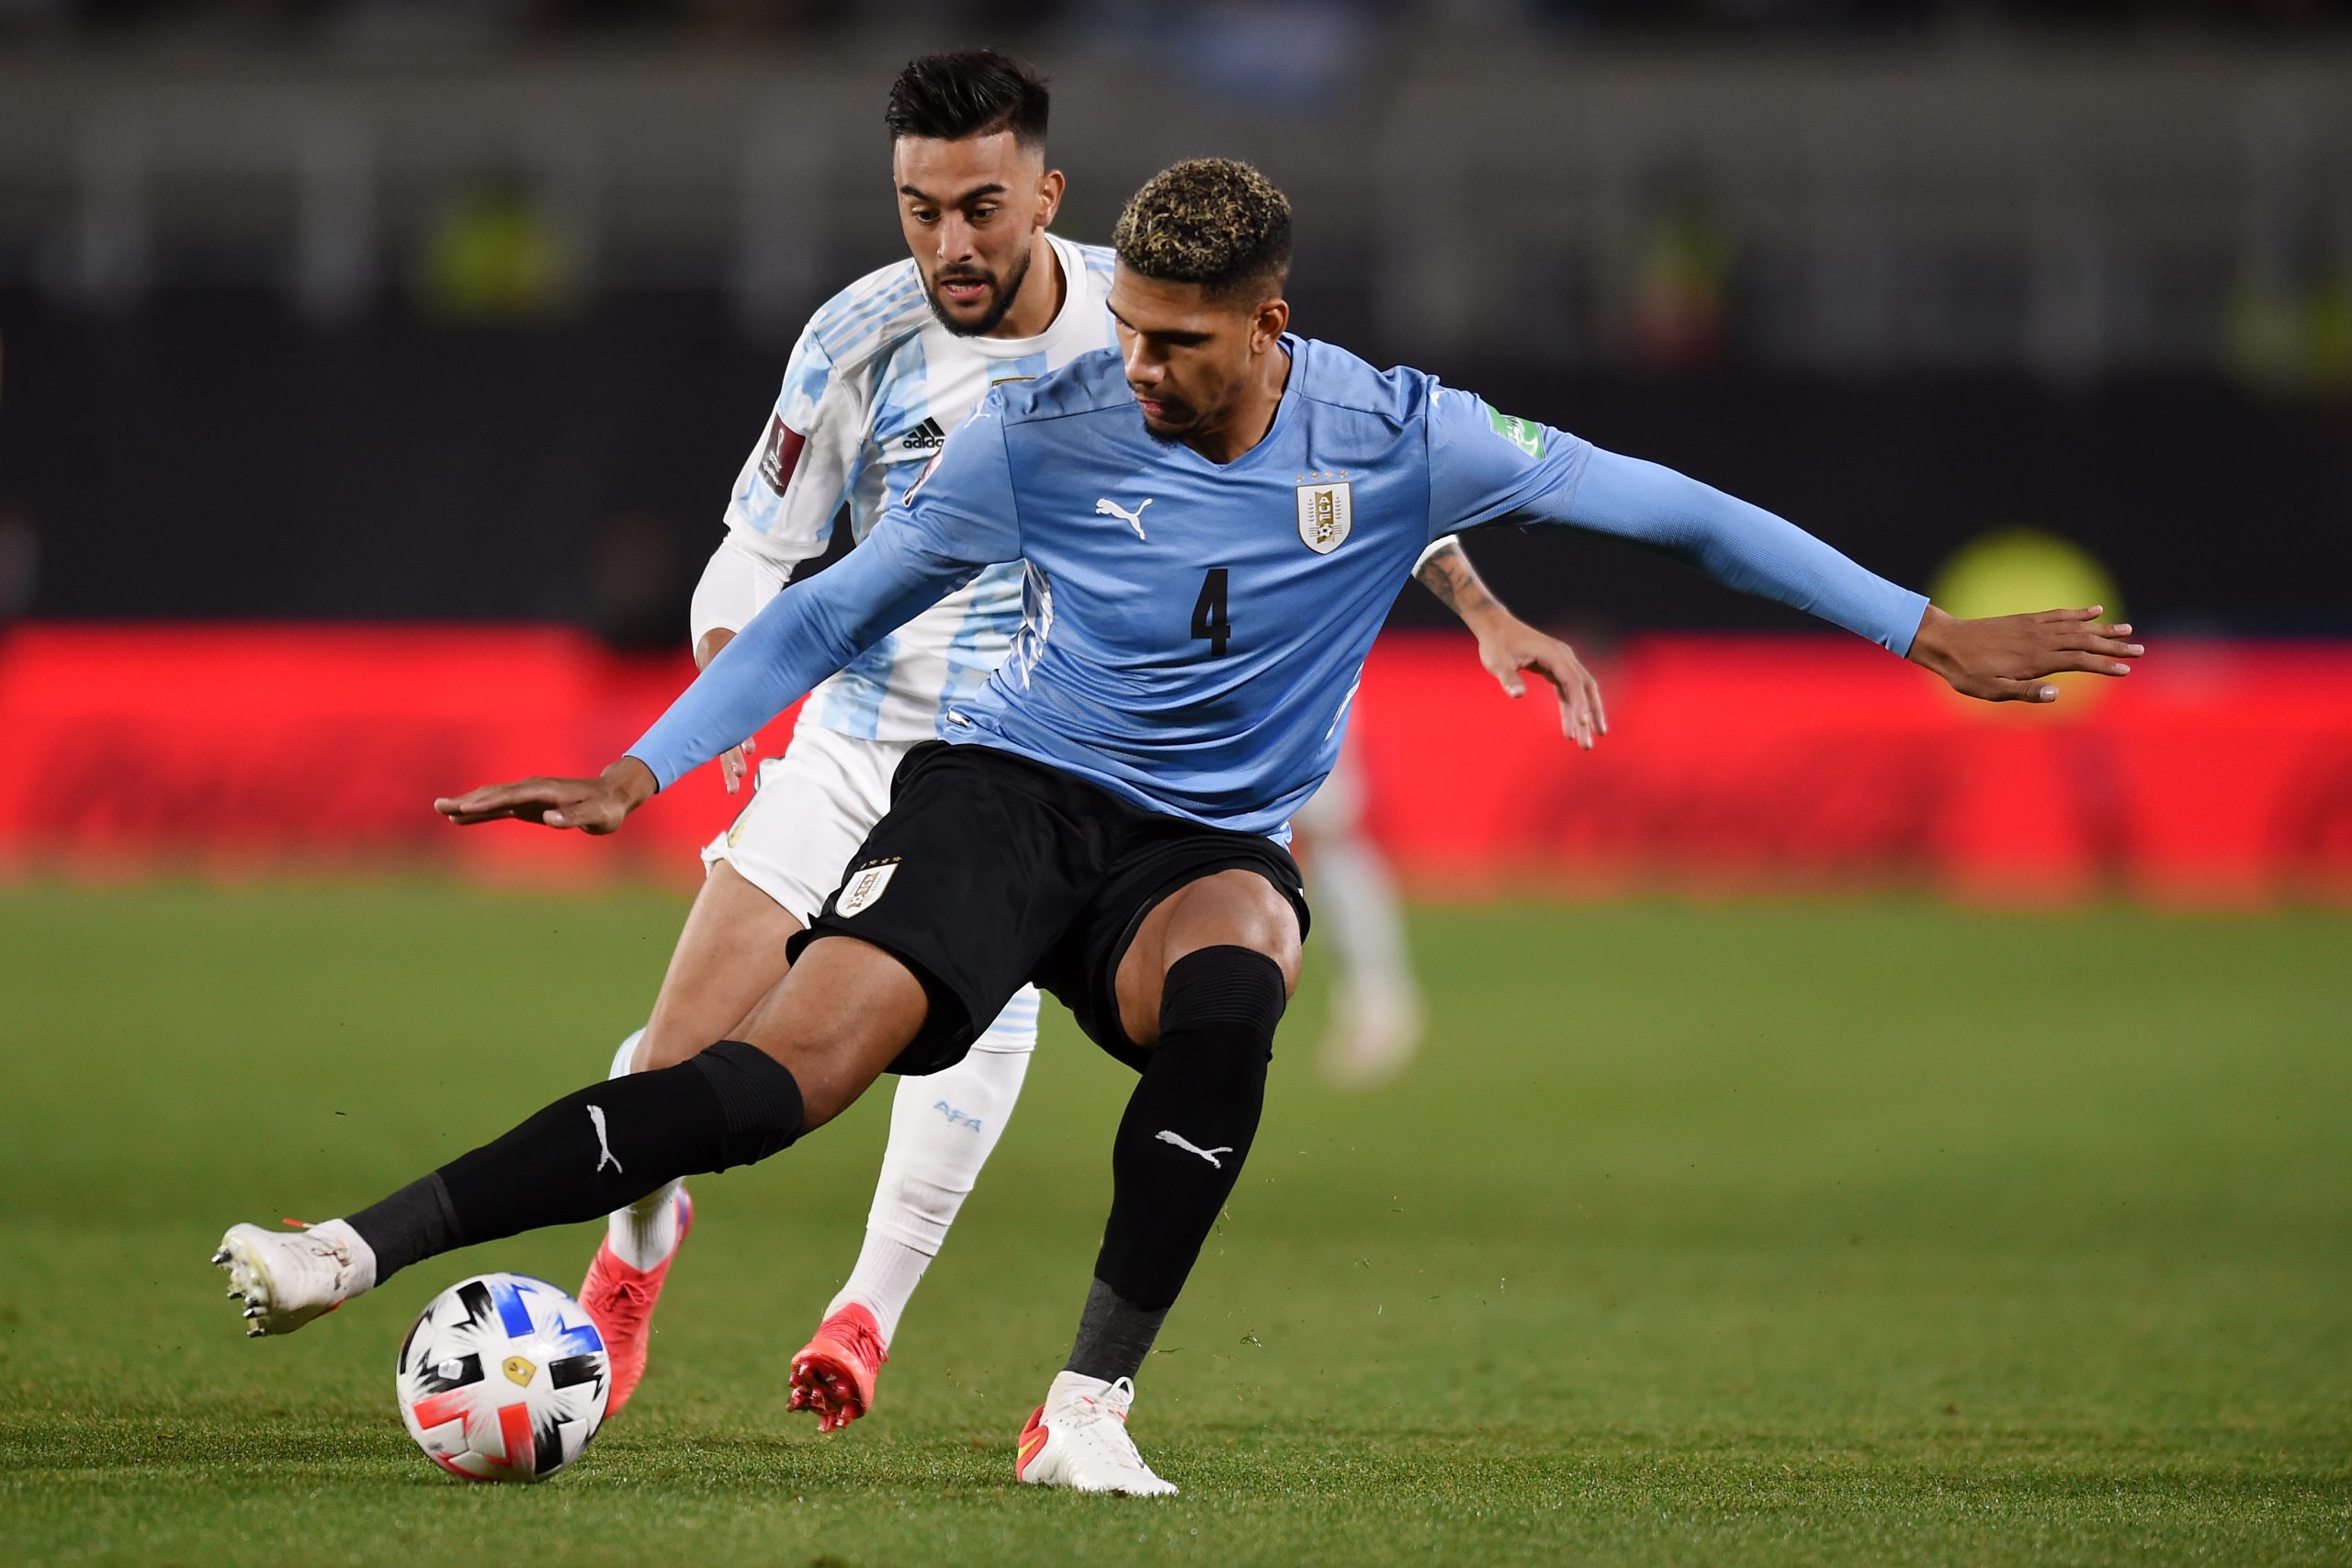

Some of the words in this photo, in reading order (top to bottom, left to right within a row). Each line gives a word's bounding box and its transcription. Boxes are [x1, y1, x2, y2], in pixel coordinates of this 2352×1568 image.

[902, 436, 944, 448] adida
[1318, 497, 1331, 522] AUF
[1191, 568, 1231, 657] 4
[933, 1101, 981, 1132] AFA
